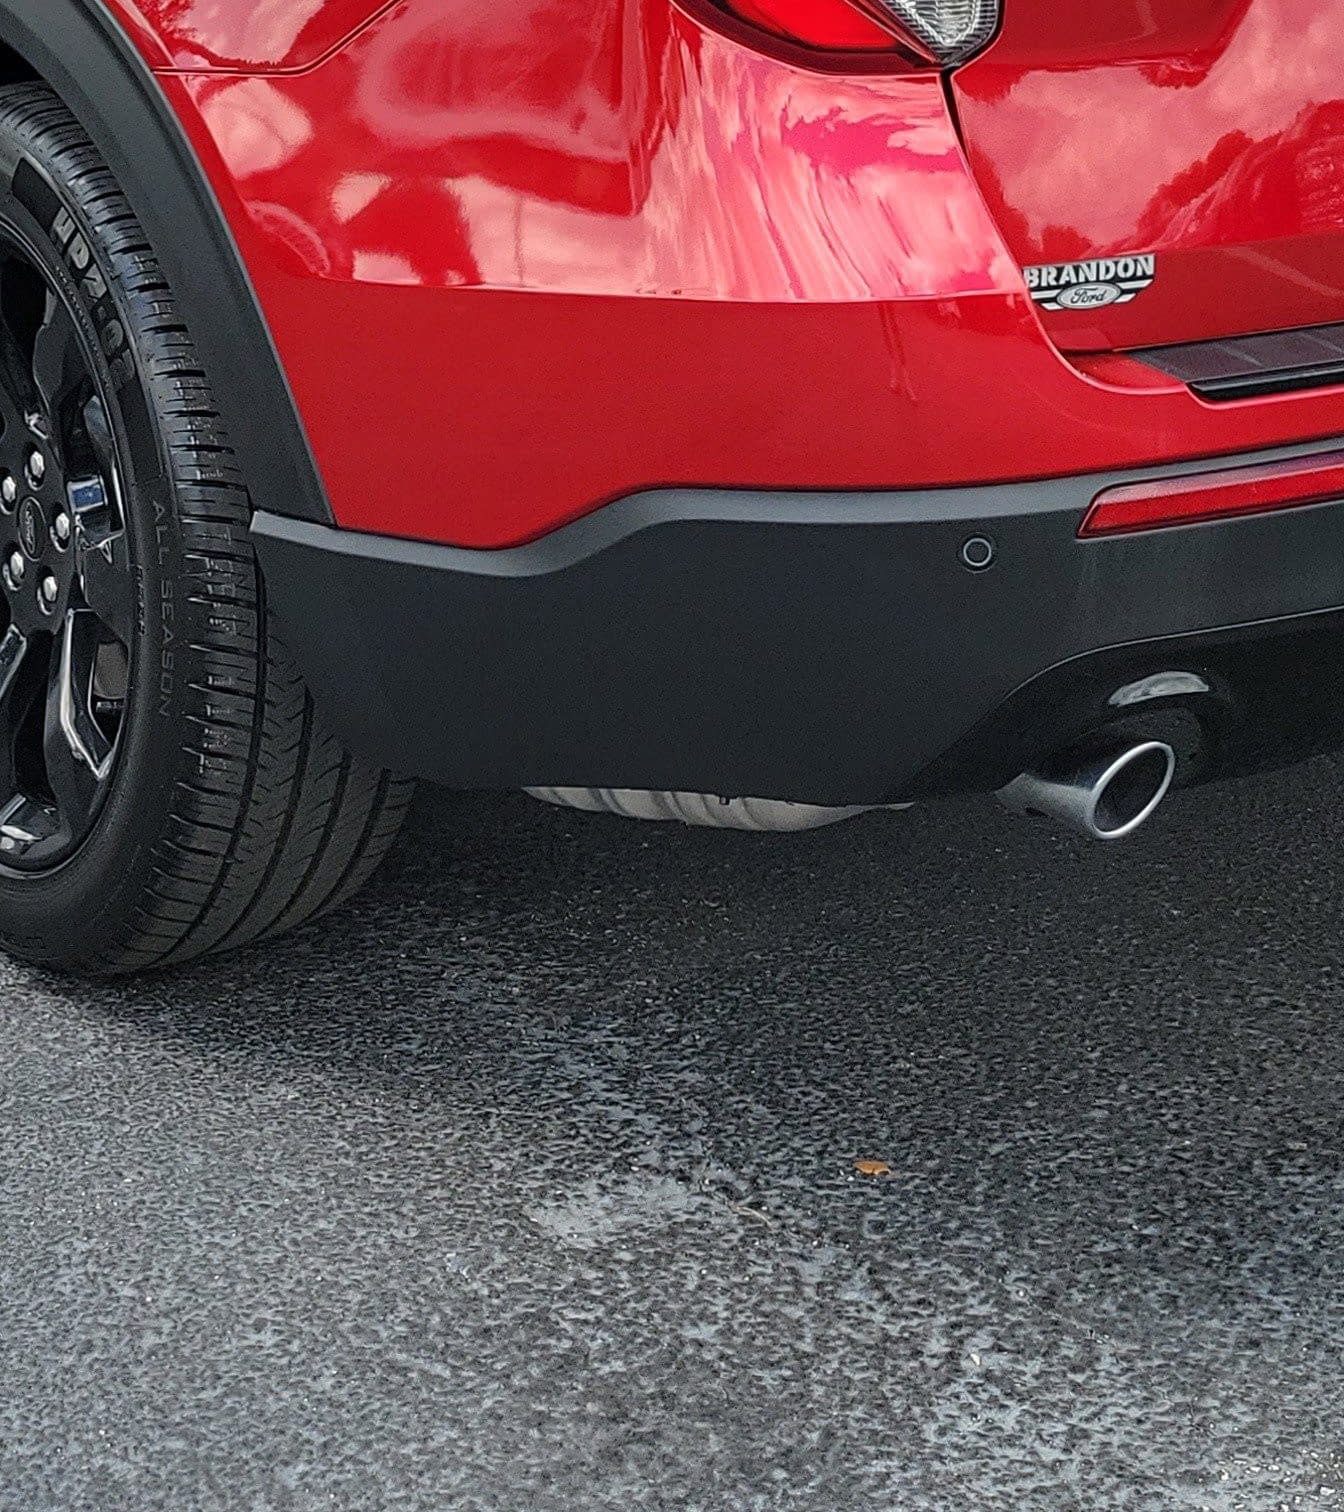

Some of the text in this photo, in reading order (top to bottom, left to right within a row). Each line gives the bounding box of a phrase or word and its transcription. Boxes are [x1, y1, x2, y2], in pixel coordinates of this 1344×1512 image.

[1023, 254, 1155, 287] BRANDON
[1070, 288, 1107, 305] Ford
[153, 500, 175, 717] ALL SEASON
